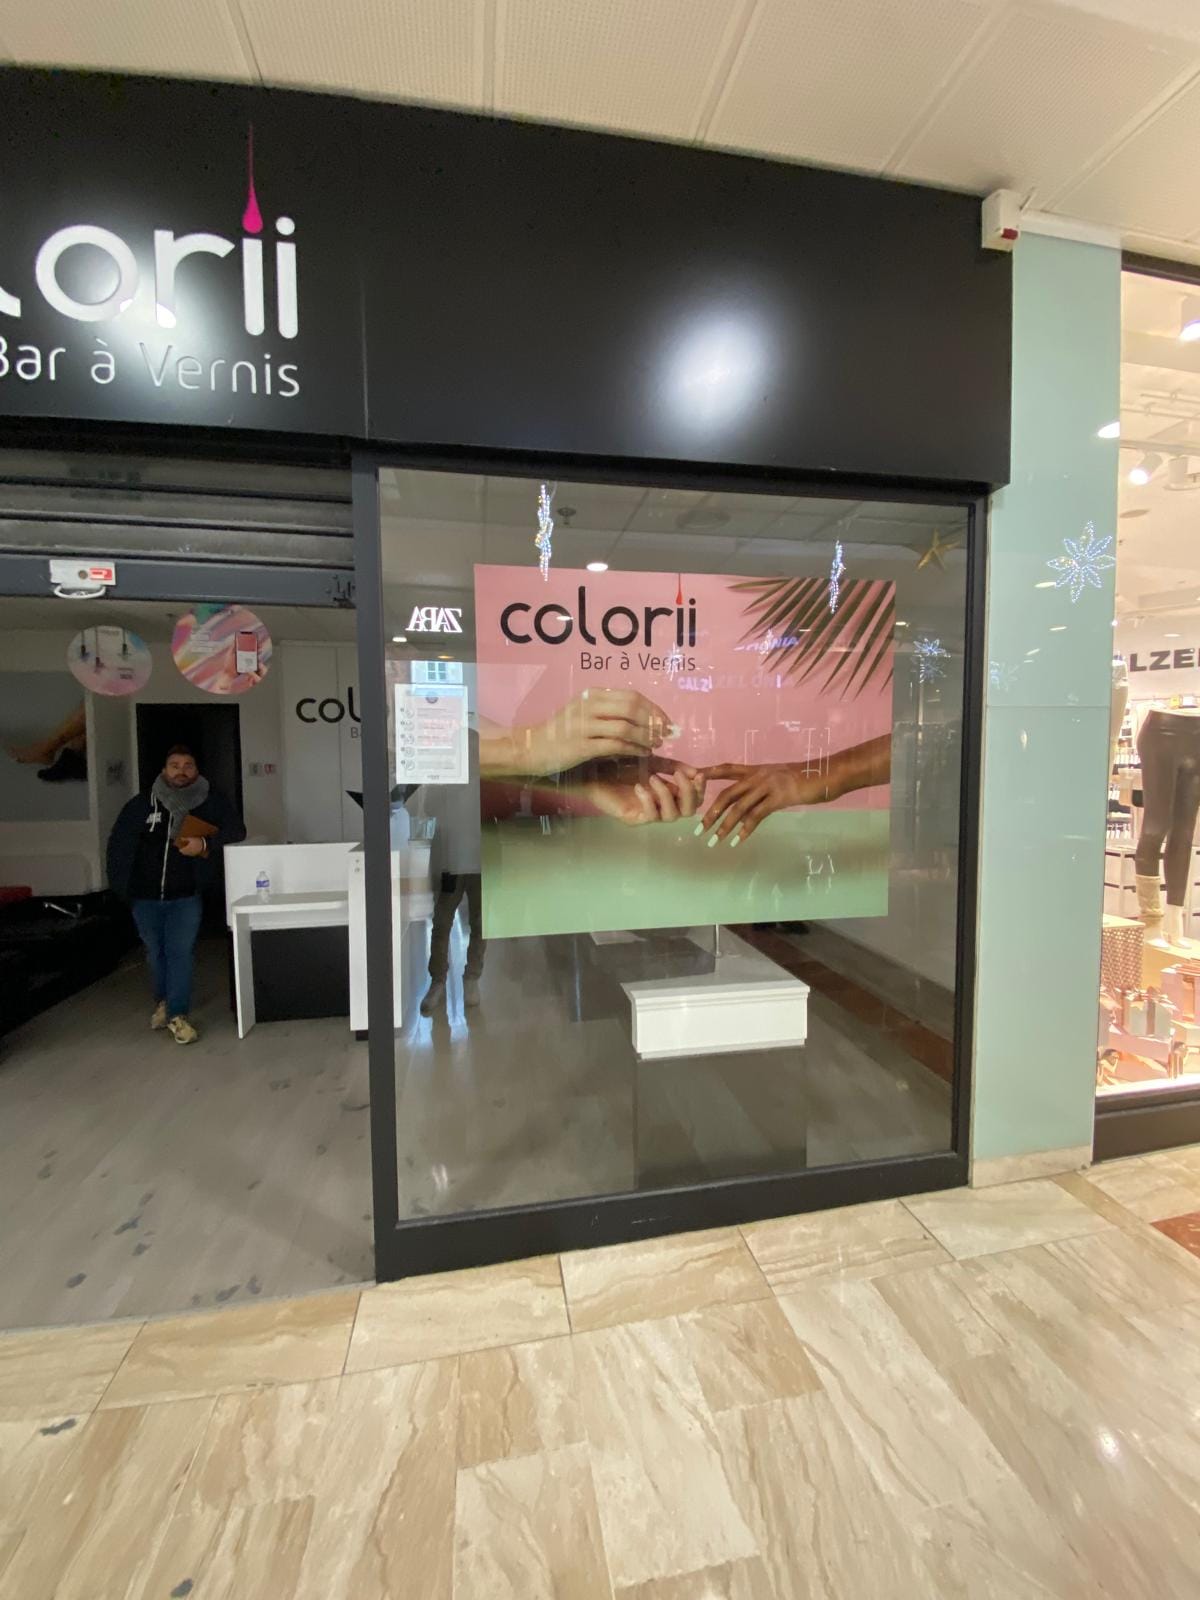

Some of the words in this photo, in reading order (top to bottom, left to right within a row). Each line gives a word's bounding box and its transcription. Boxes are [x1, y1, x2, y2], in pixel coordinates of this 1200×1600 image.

[0, 200, 299, 340] orii
[90, 338, 116, 384] à
[138, 341, 301, 398] Vernis
[500, 585, 697, 648] colorii
[580, 651, 613, 671] Bar
[620, 651, 631, 671] à
[1129, 647, 1200, 672] LZE
[350, 726, 361, 739] B
